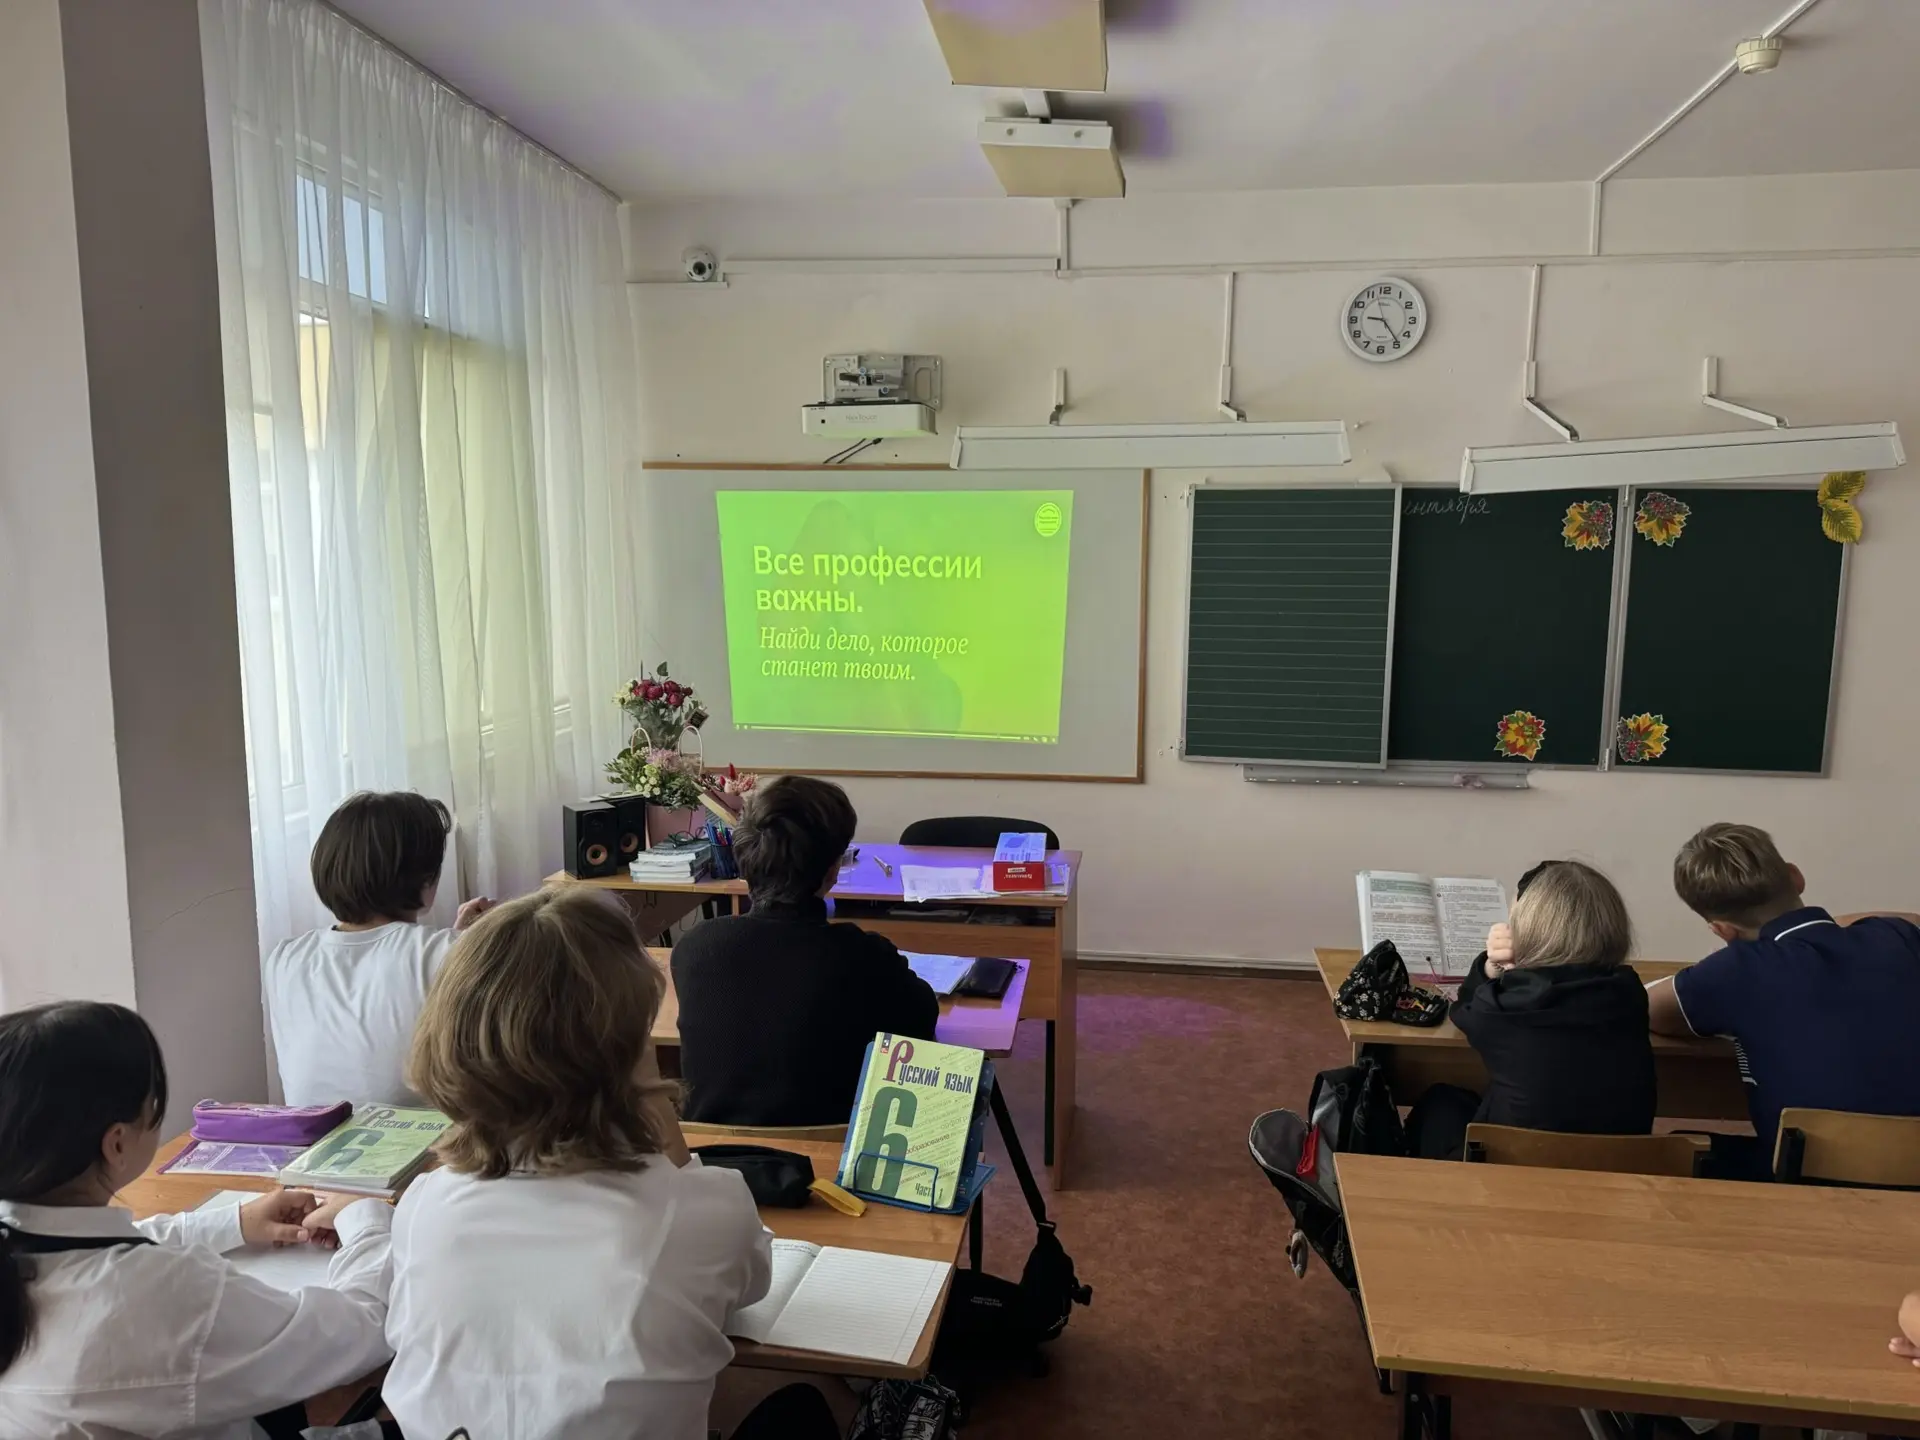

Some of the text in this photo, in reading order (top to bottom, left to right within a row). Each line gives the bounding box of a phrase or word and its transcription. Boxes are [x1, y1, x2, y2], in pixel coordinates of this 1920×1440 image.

[1367, 290, 1375, 299] 11
[1379, 286, 1392, 295] 12
[1398, 290, 1402, 300] 1
[1354, 300, 1365, 309] 10
[1404, 301, 1413, 310] 2
[1349, 315, 1358, 325] 9
[1408, 316, 1417, 325] 3
[1353, 330, 1362, 338] 8
[1402, 330, 1411, 339] 4
[1363, 340, 1371, 349] 7
[1392, 341, 1401, 350] 5
[1376, 345, 1385, 355] 6
[1404, 495, 1491, 524] ентября
[753, 545, 982, 585] Все профессии
[756, 588, 863, 613] важны.
[760, 626, 969, 659] Найди дело, которое
[761, 659, 916, 681] станет твоим.
[882, 1039, 974, 1094] Русский язык
[356, 1109, 447, 1131] Русский язык
[853, 1086, 918, 1199] 6
[303, 1128, 385, 1174] 6
[915, 1182, 933, 1197] Част
